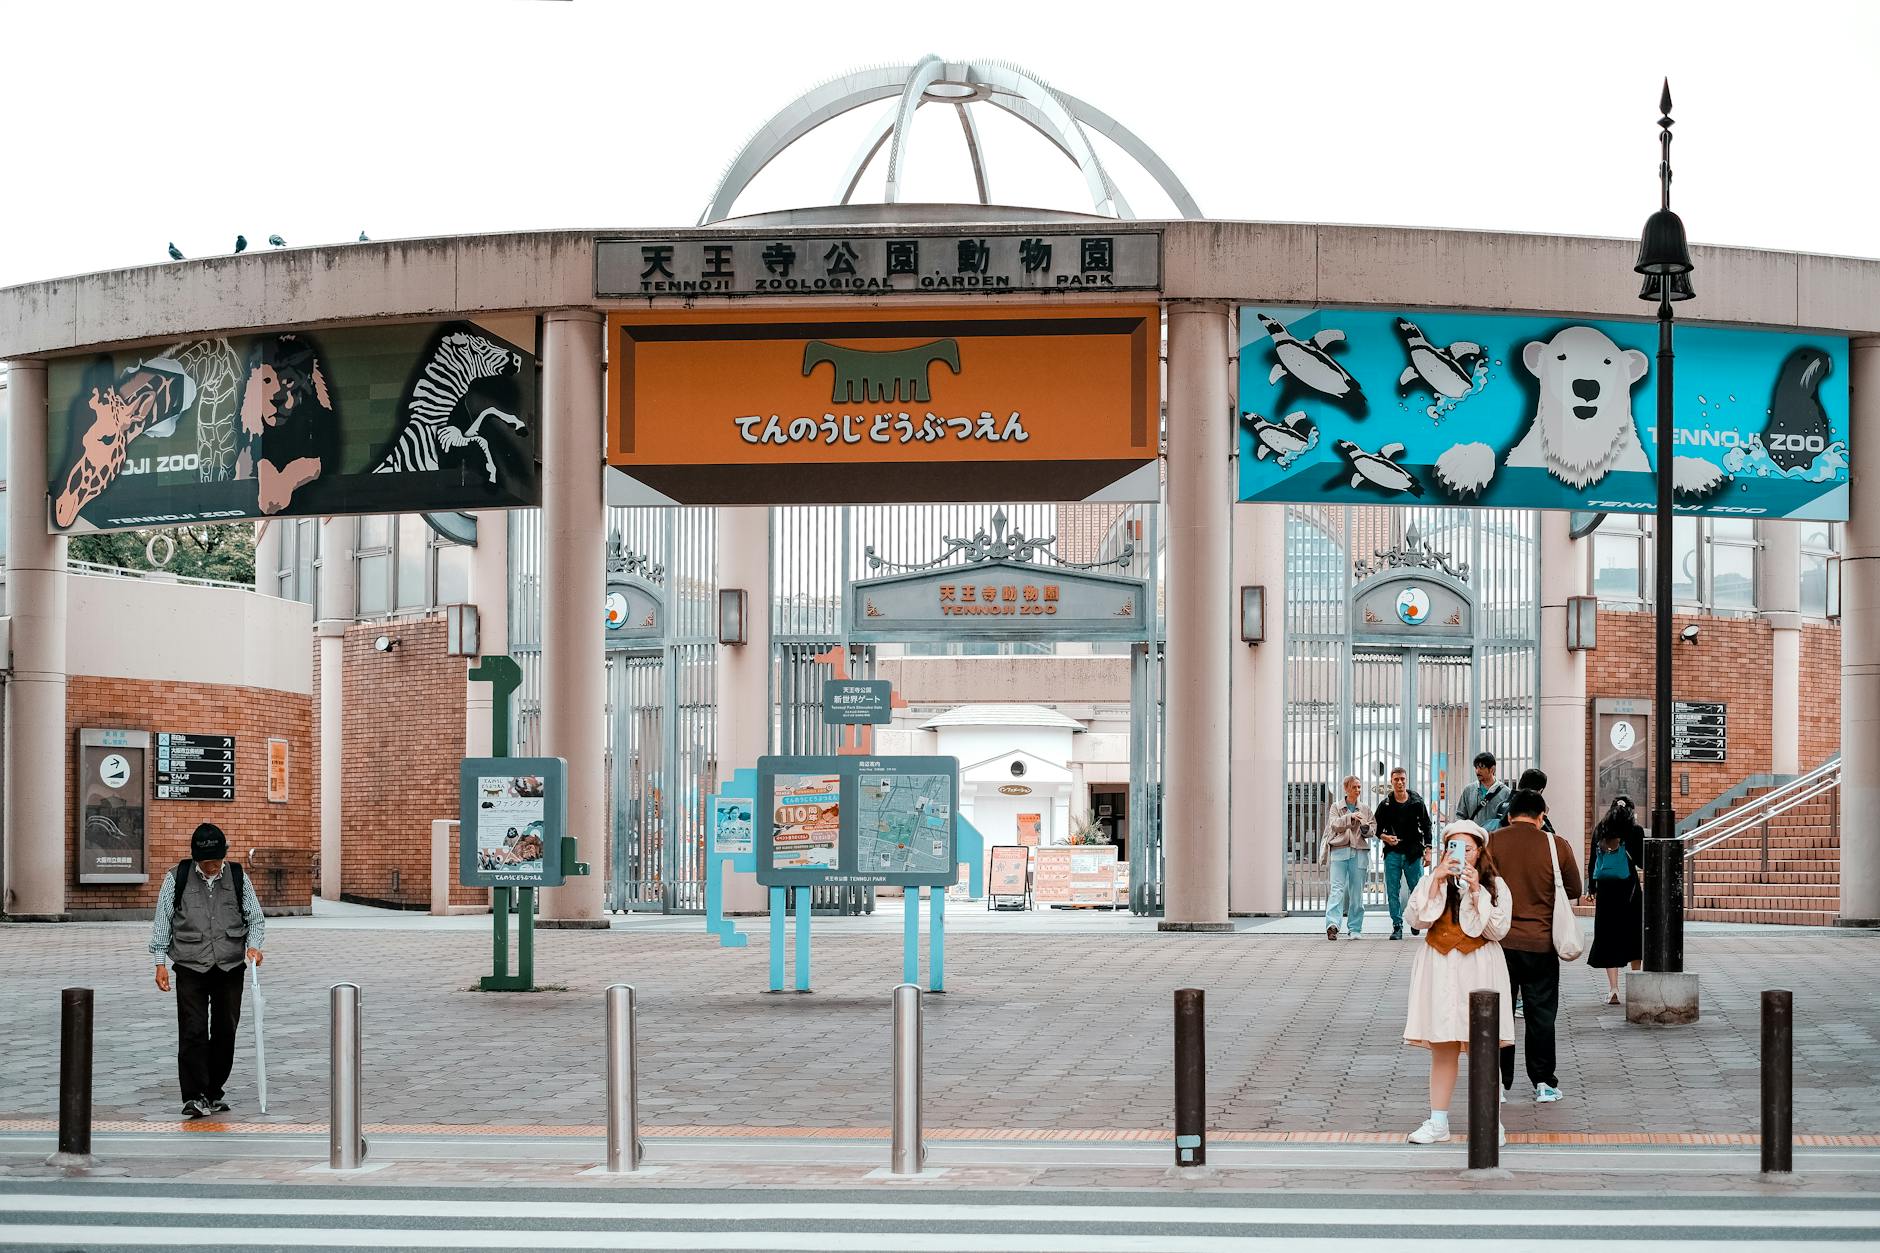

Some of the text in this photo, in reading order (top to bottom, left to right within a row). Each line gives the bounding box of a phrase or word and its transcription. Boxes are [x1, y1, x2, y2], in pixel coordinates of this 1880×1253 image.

[641, 238, 1114, 279] 天王寺公園動物園
[641, 274, 1114, 291] TENNOJI ZOOLOGICAL GARDEN PARK
[1769, 433, 1825, 453] ZOO
[156, 453, 200, 472] ZOO
[107, 510, 246, 524] TENNOJI ZOO
[1707, 506, 1768, 514] ZOO
[939, 584, 1060, 602] 天王寺動物園
[941, 605, 1058, 616] TENNOJI ZOO
[833, 695, 881, 704] 新世界ゲート
